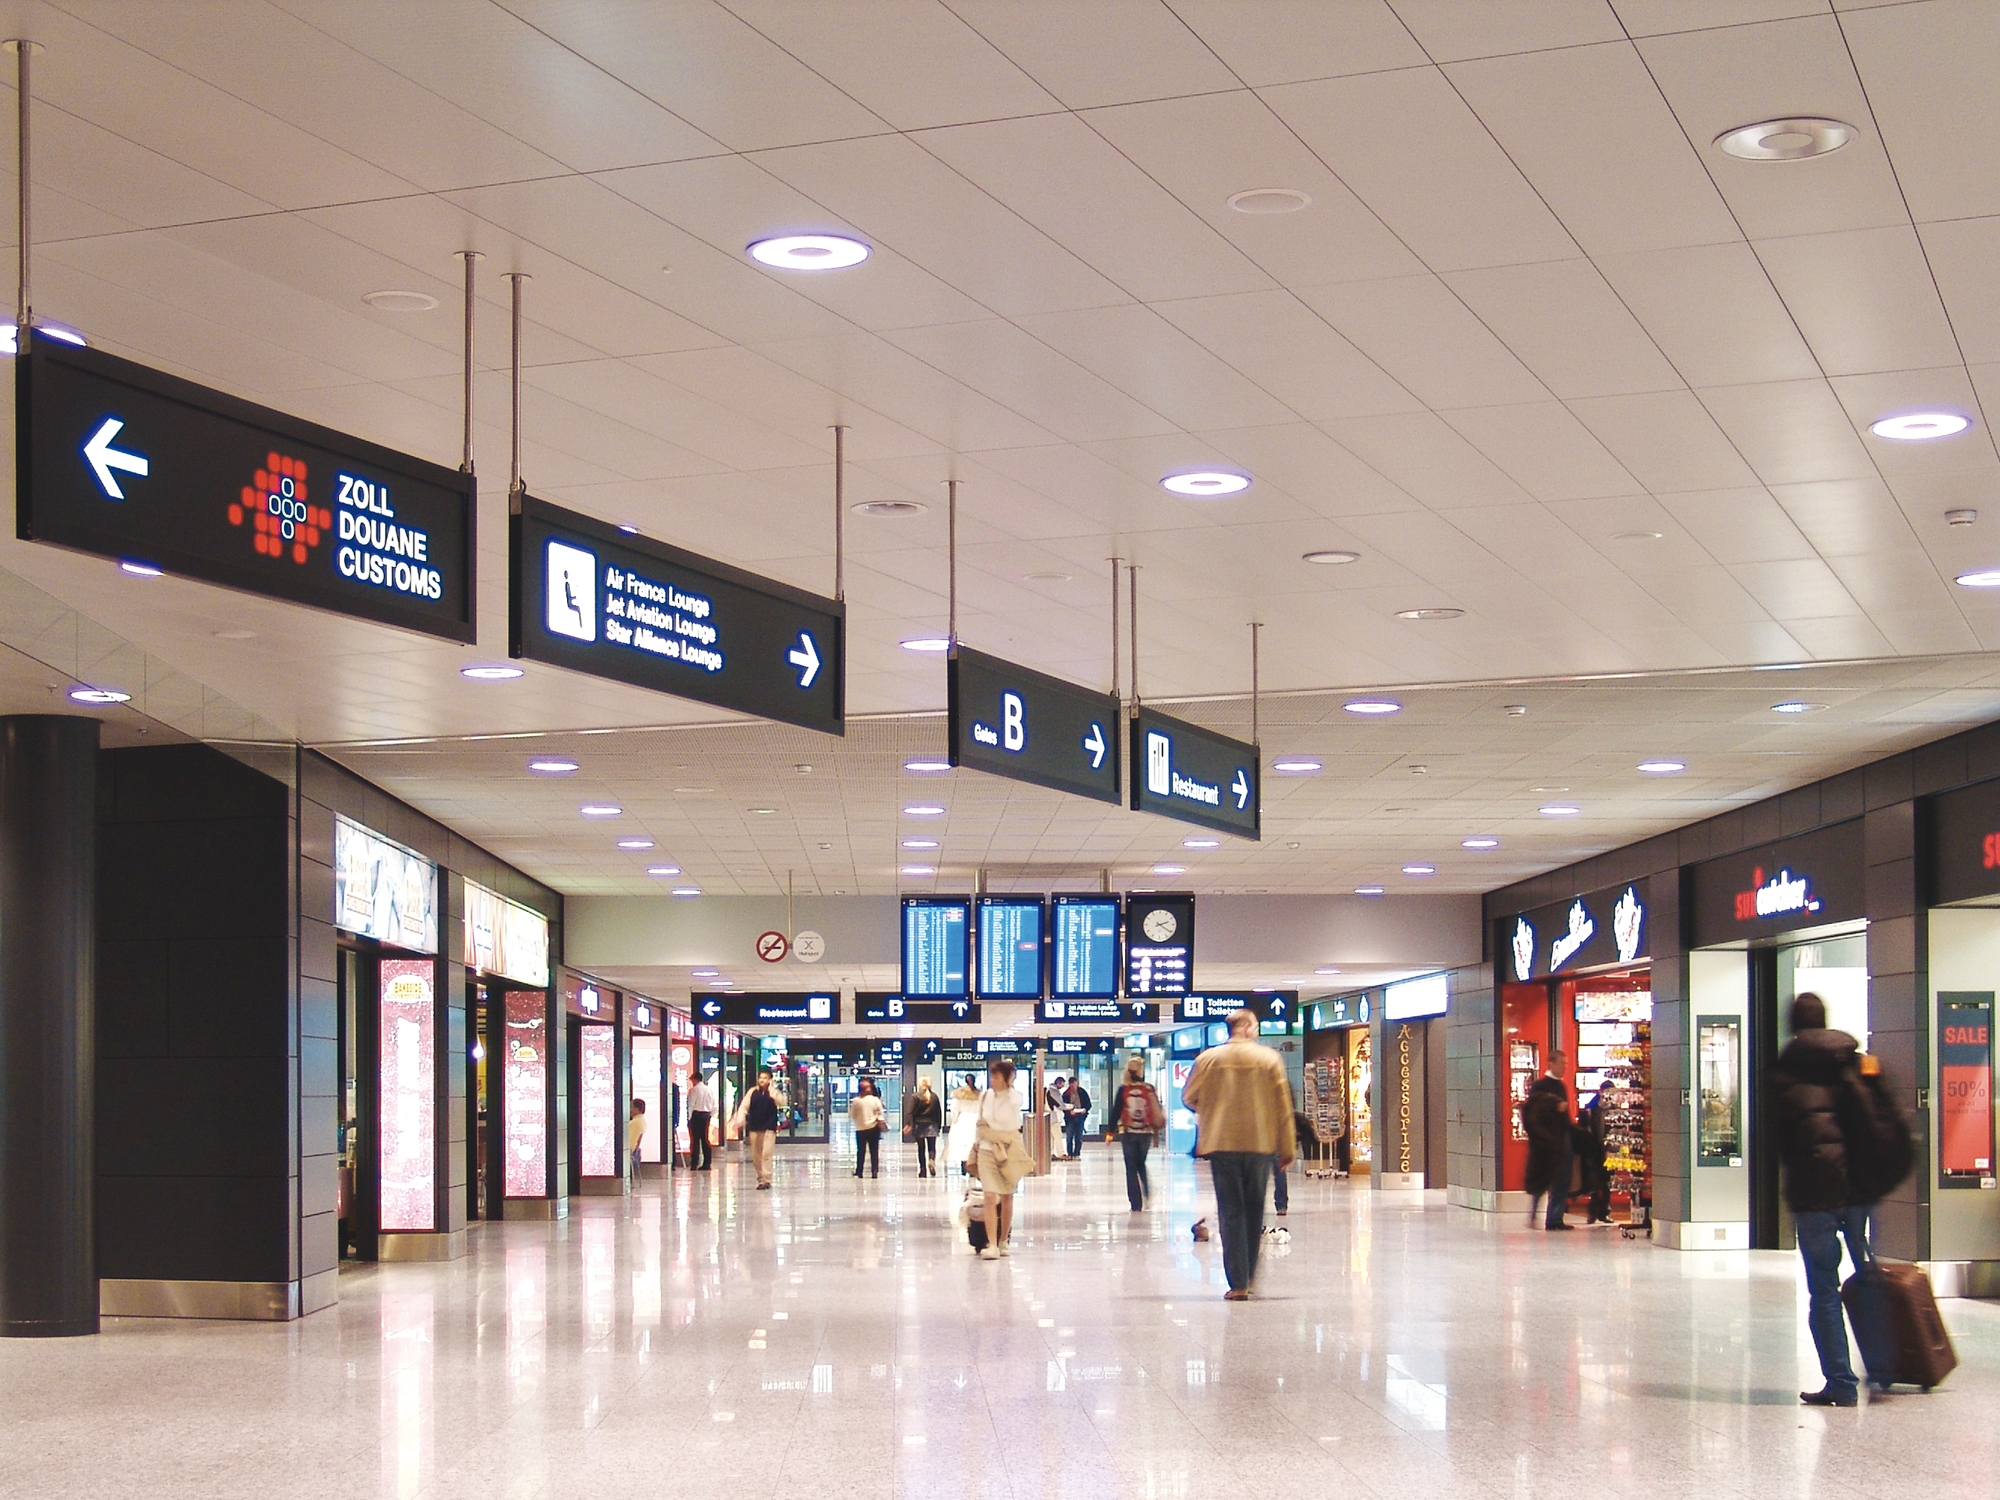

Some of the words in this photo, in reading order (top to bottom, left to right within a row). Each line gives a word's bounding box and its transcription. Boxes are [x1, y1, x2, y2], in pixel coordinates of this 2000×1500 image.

[338, 474, 394, 518] ZOLL
[339, 510, 427, 562] DOUANE
[339, 546, 441, 599] CUSTOMS
[606, 567, 624, 590] Air
[626, 573, 667, 603] France
[668, 586, 710, 618] Lounge
[606, 593, 625, 617] Jet
[626, 599, 673, 631] Aviation
[675, 613, 717, 645] Lounge
[606, 618, 633, 644] Star
[633, 627, 680, 658] Alliance
[680, 640, 723, 671] Lounge
[974, 723, 998, 746] Gates
[1004, 693, 1024, 751] B
[1172, 771, 1219, 805] Restaurant
[759, 1008, 807, 1017] Restaurant
[889, 1000, 903, 1017] B
[1206, 998, 1244, 1007] Toiletten
[1944, 1026, 1989, 1044] SALE
[1947, 1081, 1985, 1097] 50%
